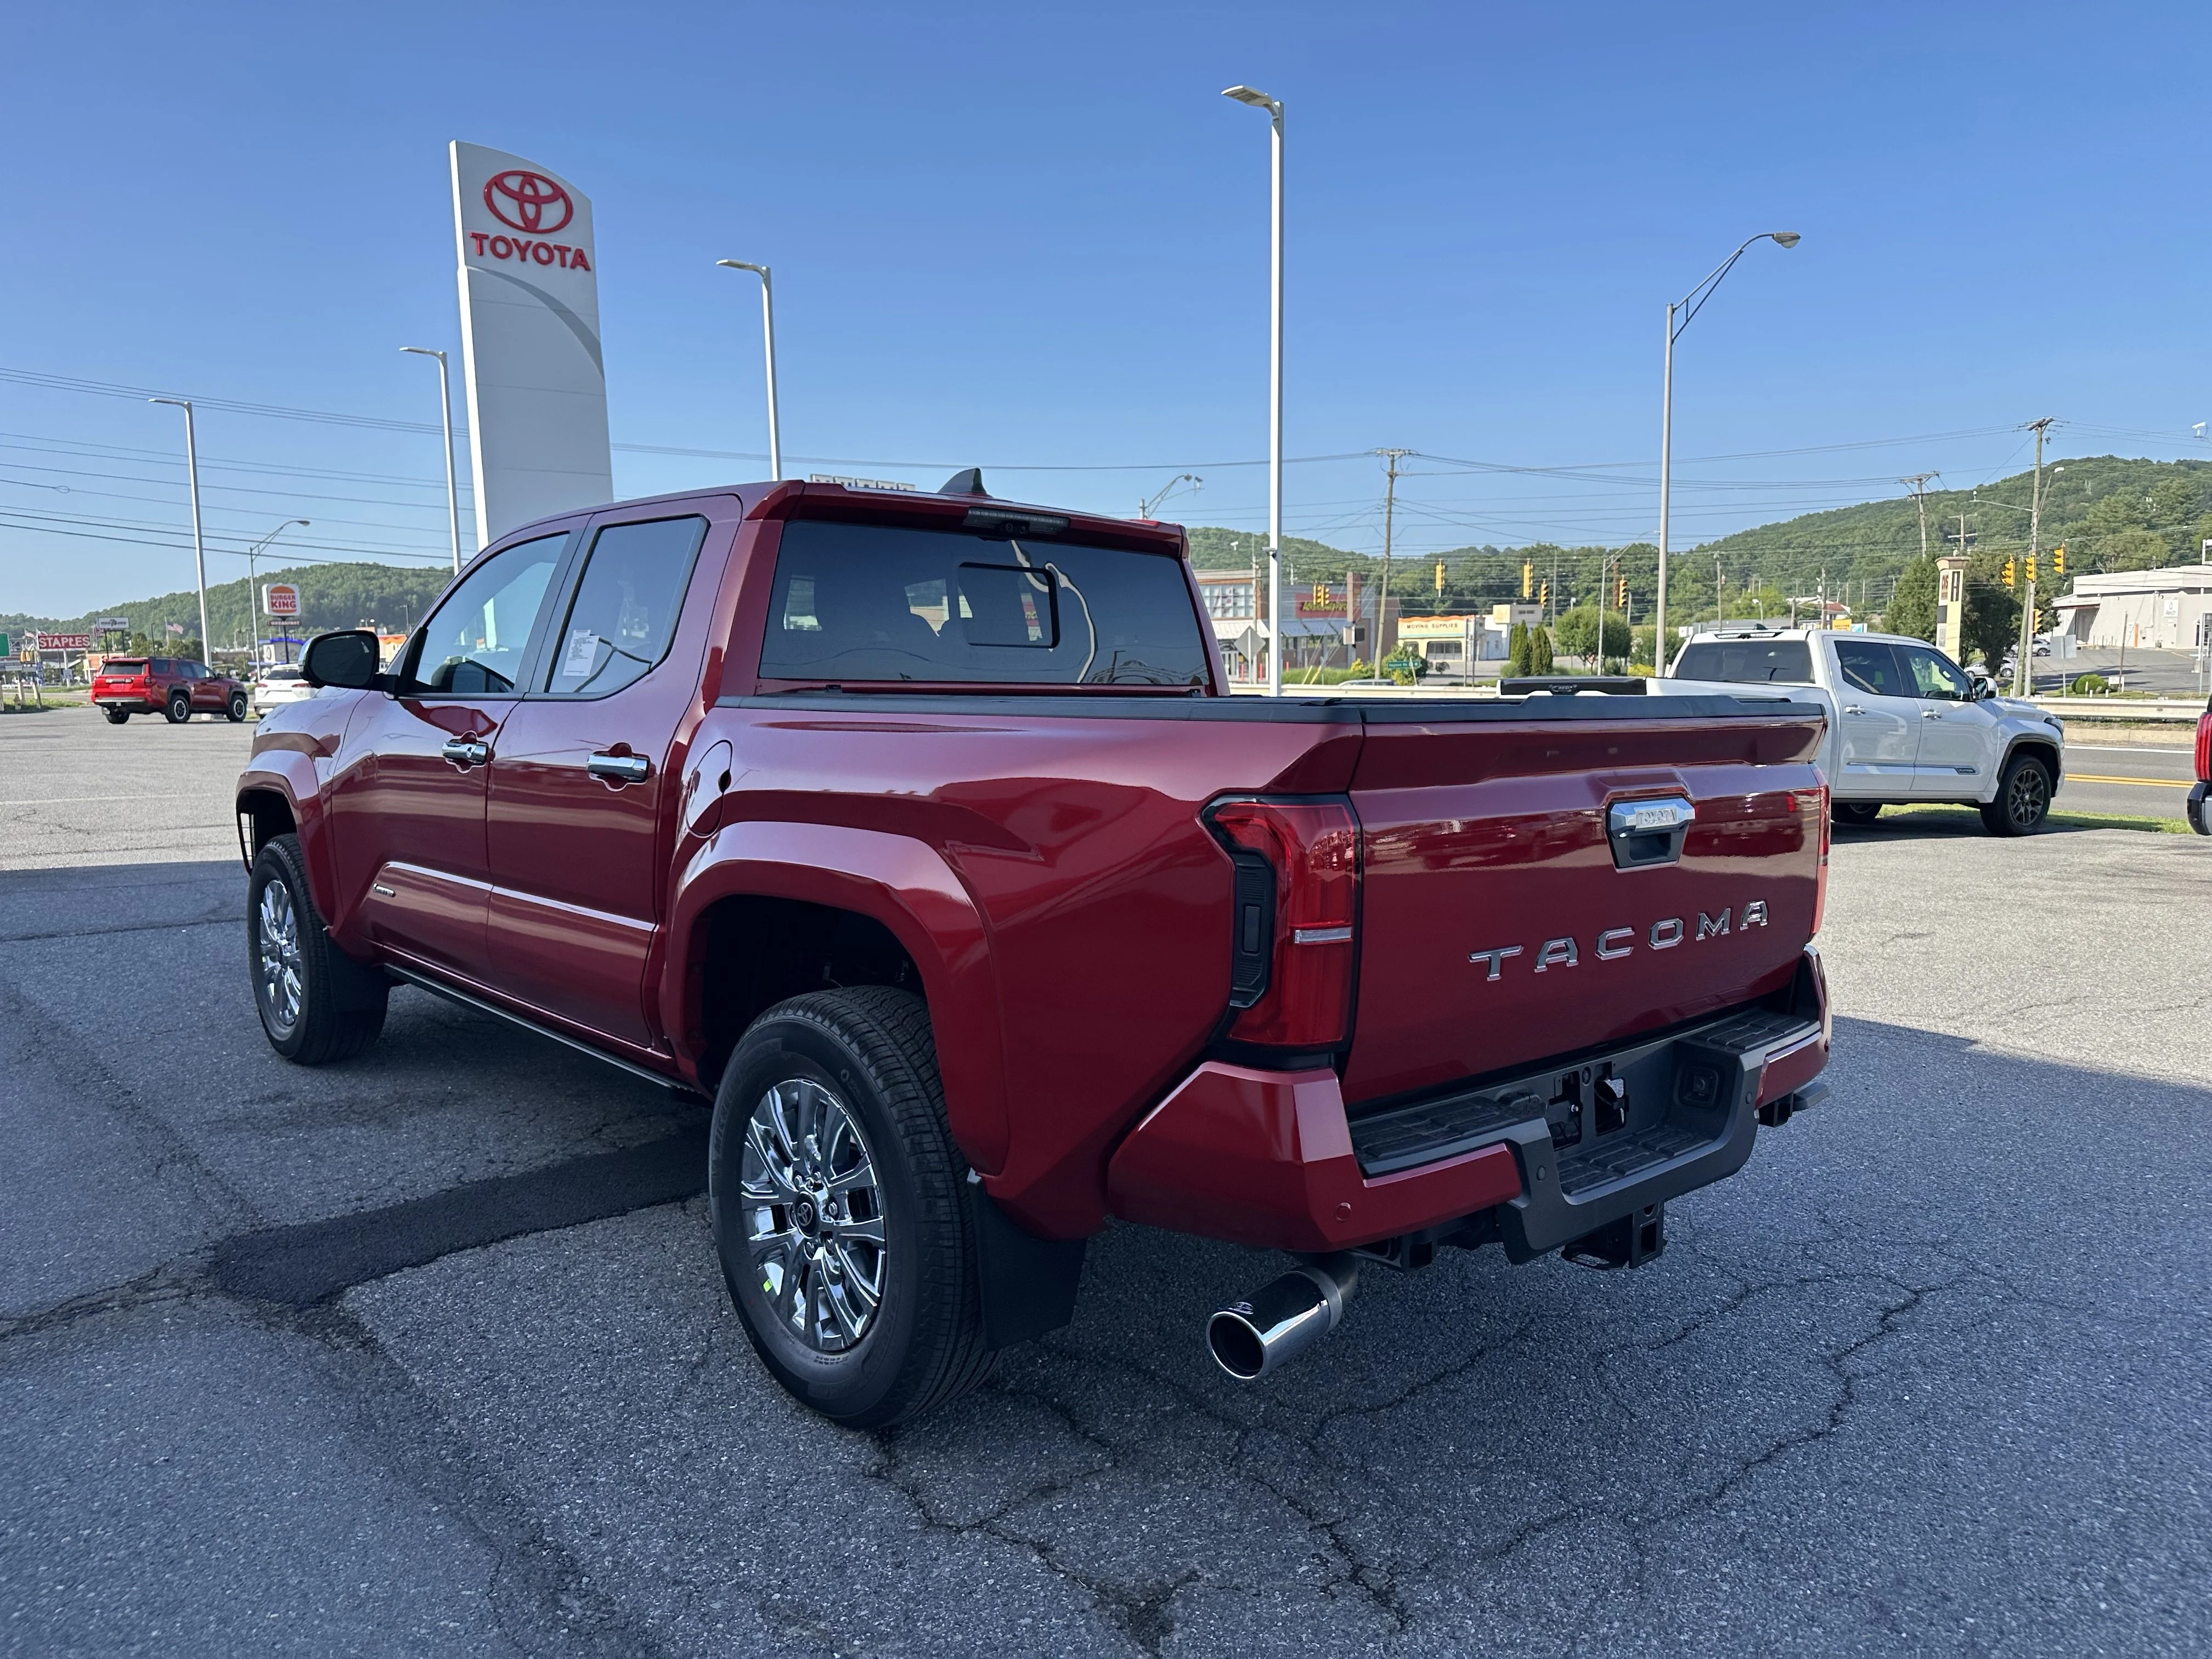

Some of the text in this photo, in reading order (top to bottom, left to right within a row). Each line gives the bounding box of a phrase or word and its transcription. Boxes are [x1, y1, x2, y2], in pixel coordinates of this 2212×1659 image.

[469, 232, 591, 271] TOYOTA
[39, 636, 90, 648] STAPLES
[1637, 809, 1675, 824] TOYOTA
[1468, 900, 1769, 981] TACOMA
